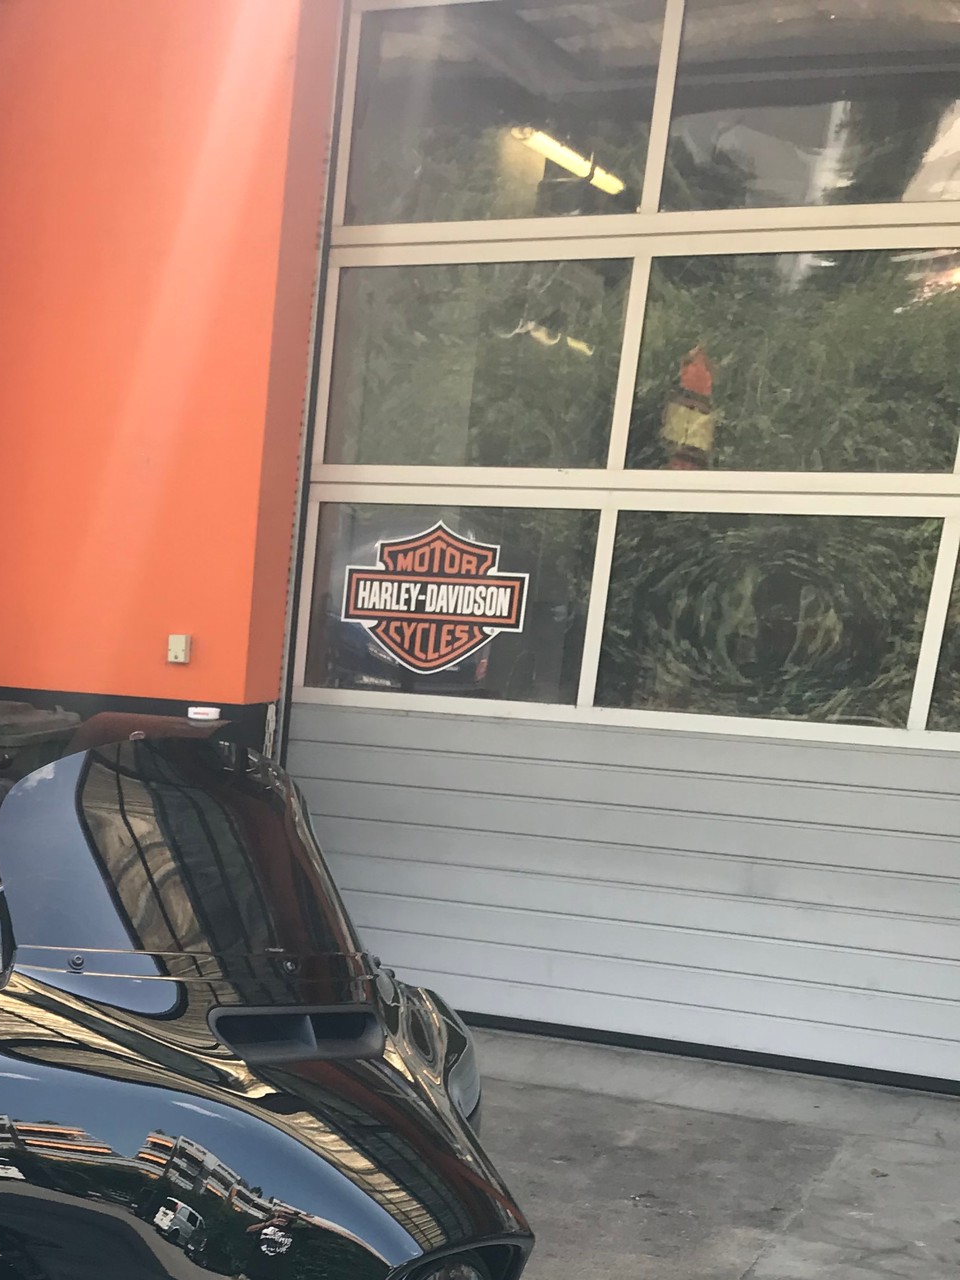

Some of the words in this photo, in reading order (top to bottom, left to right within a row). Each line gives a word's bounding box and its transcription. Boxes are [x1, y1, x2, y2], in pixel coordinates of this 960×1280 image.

[397, 540, 477, 575] MOTOR
[357, 580, 511, 617] HARLEY-DAVIDSON
[389, 621, 469, 661] CYCLES
